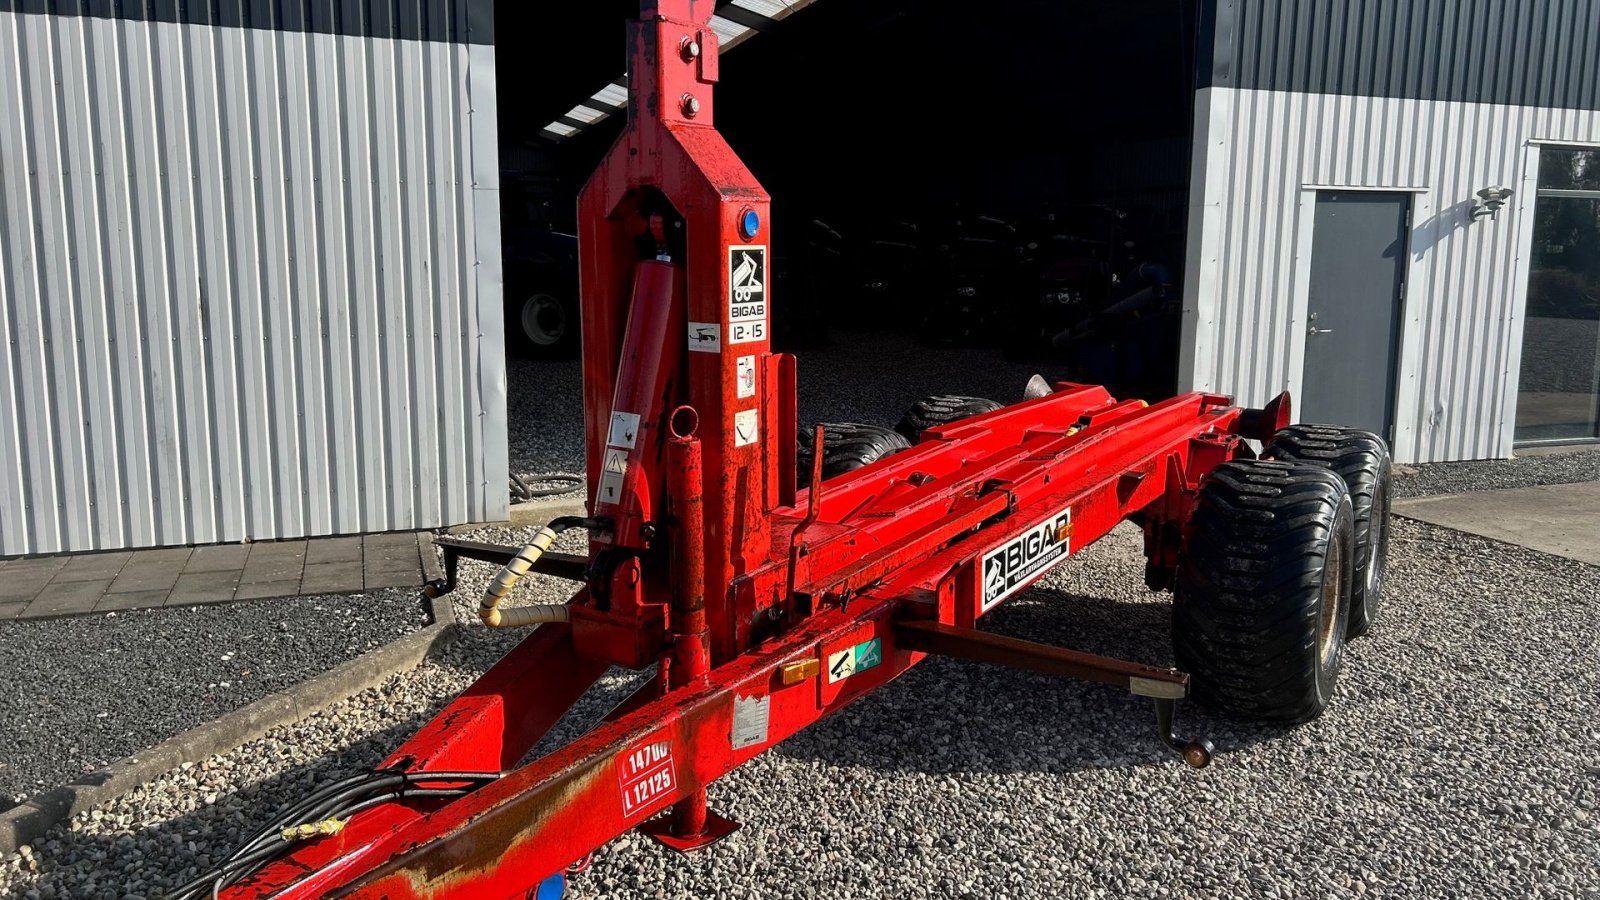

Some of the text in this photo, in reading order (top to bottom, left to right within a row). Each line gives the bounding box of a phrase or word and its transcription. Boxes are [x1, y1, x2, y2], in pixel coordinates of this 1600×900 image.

[732, 305, 764, 317] BIGAB
[625, 789, 633, 811] L
[634, 767, 671, 804] 12125
